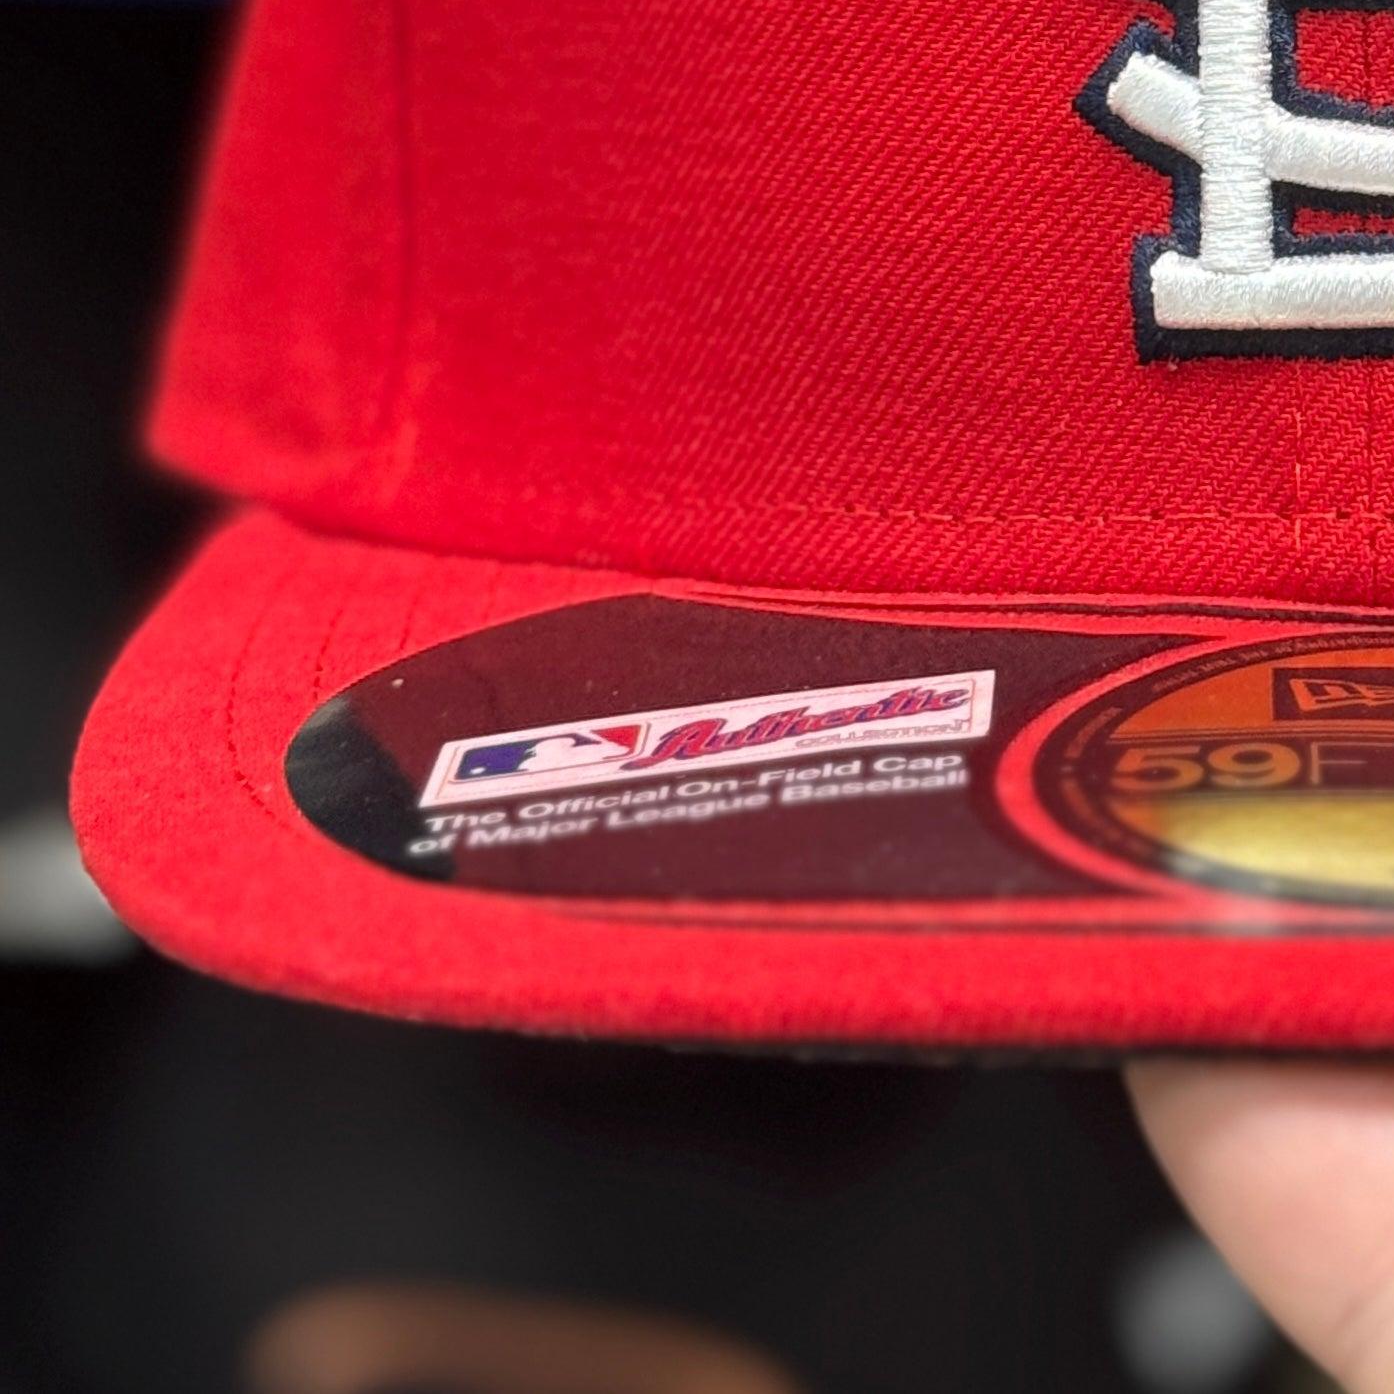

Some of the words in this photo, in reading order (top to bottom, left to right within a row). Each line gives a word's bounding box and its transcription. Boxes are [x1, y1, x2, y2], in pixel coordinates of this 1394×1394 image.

[619, 686, 971, 770] Authentic
[795, 719, 971, 749] COLLECTION
[408, 833, 457, 855] of
[465, 815, 600, 846] Major
[607, 793, 771, 830] League
[779, 769, 968, 804] Baseball
[426, 810, 506, 833] The
[517, 785, 670, 820] Official
[675, 759, 862, 797] On-Field
[872, 753, 964, 774] Cap
